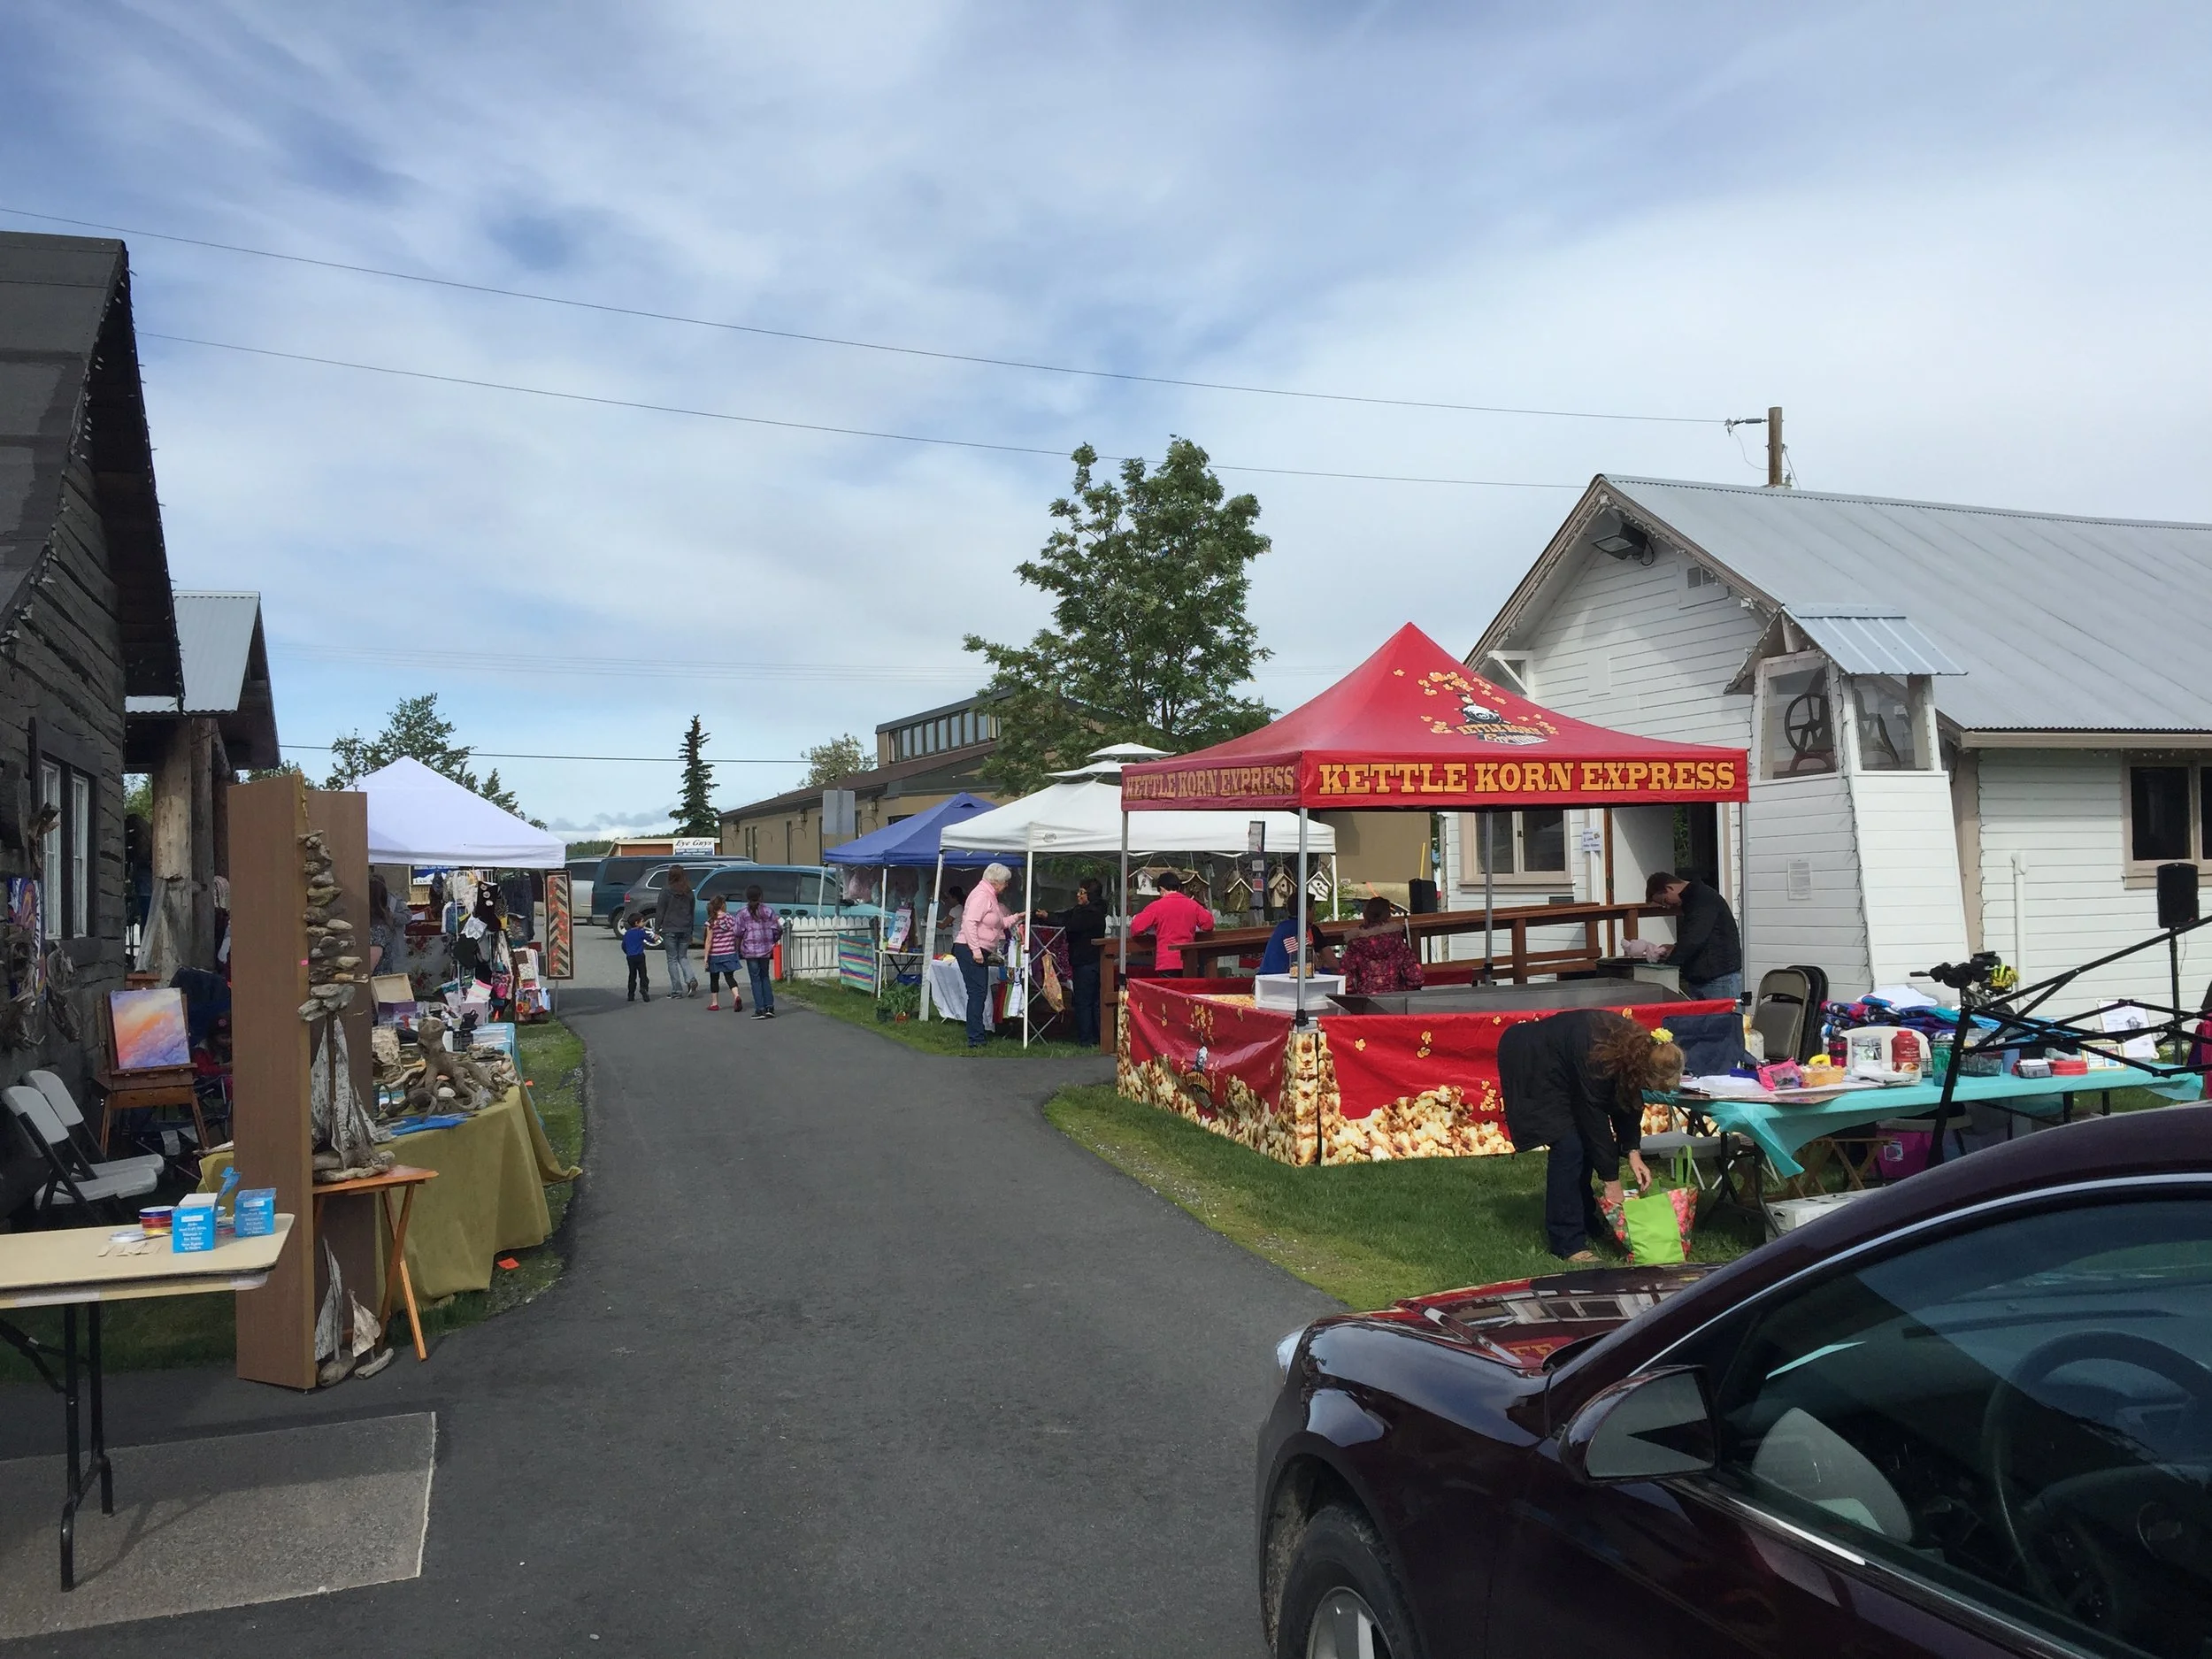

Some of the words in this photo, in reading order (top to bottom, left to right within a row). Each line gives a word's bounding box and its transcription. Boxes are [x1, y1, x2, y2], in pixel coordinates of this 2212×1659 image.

[1125, 772, 1177, 800] KETTLE
[1178, 769, 1217, 798] KORN
[1220, 764, 1295, 795] EXPRESS
[1317, 763, 1469, 795] KETTLE
[1474, 762, 1573, 793] KORN
[1580, 761, 1735, 791] EXPRESS
[692, 839, 712, 848] Guys
